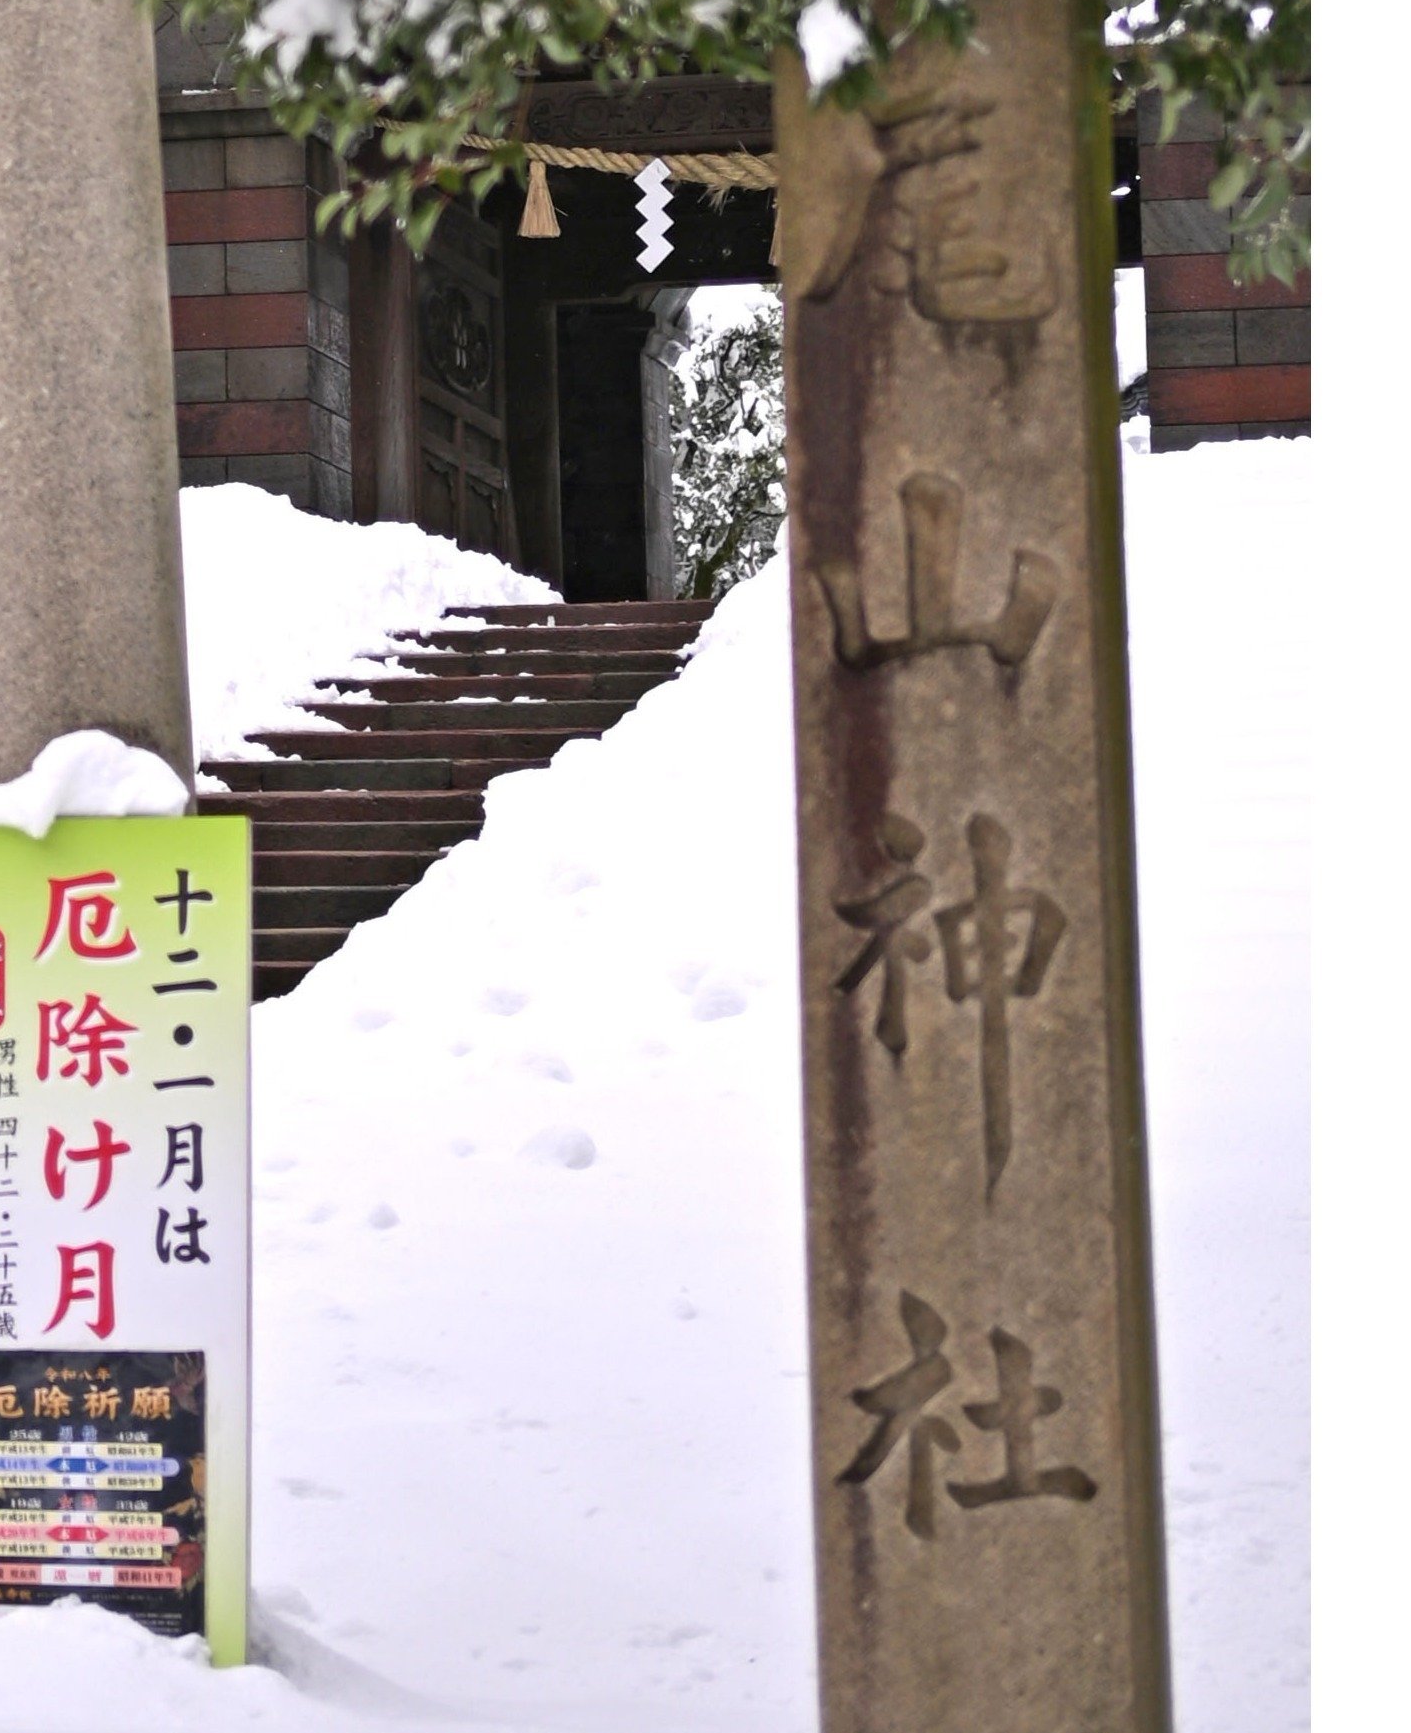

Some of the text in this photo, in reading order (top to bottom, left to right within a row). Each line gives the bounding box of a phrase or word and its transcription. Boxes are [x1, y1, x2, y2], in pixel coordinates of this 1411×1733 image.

[793, 87, 1099, 1542] 尾山神社
[33, 870, 140, 1340] 厄除け月
[151, 868, 218, 1265] 十二・一月は
[44, 1366, 112, 1382] 令和八年
